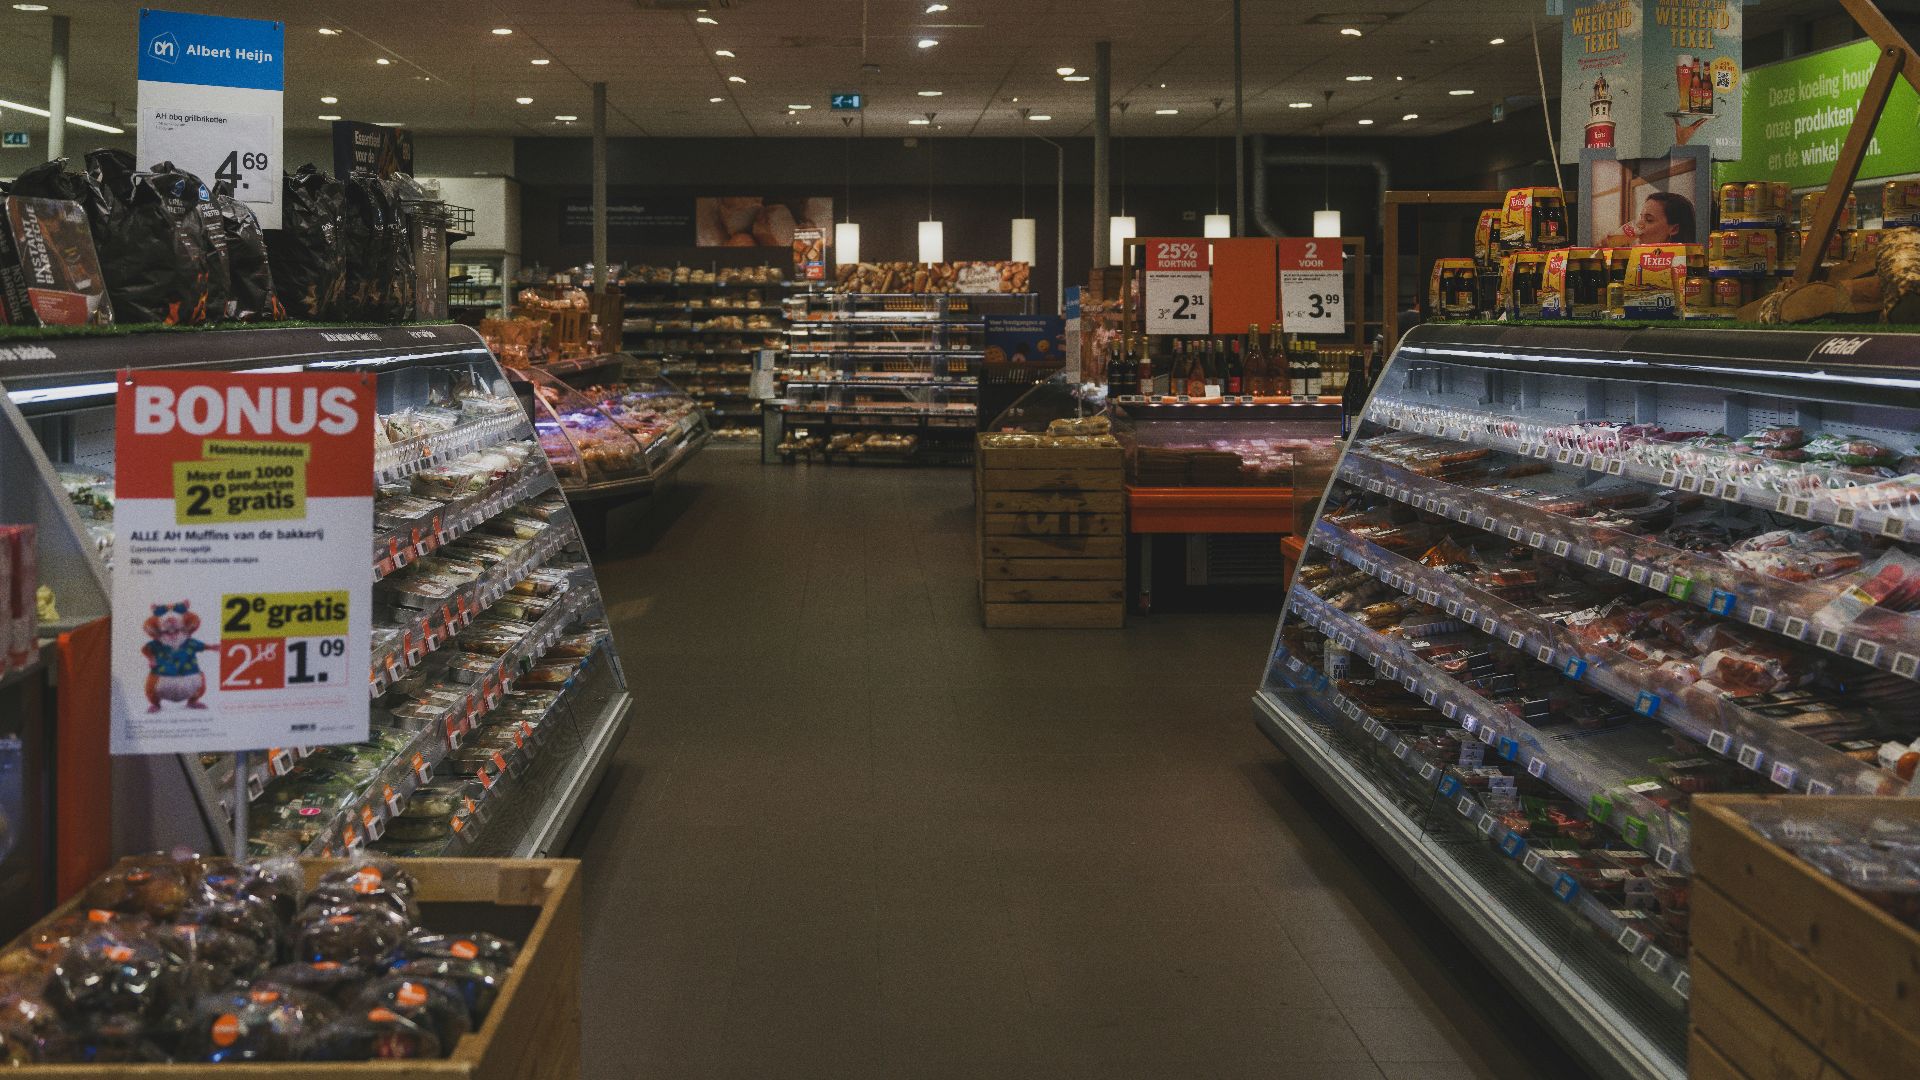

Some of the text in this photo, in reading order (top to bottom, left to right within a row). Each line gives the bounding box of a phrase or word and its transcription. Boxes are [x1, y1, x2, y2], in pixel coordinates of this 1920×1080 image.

[1572, 9, 1633, 36] WEEKEND
[1656, 7, 1730, 30] WEEKEND
[1584, 32, 1620, 54] TEXEL
[1671, 29, 1715, 49] TEXEL
[186, 43, 273, 64] Albert Heijn
[1768, 62, 1877, 108] Deze koeling houd
[155, 112, 168, 121] AH
[1766, 119, 1791, 140] onze
[1794, 105, 1853, 140] produkten
[1768, 153, 1781, 171] en
[1785, 145, 1798, 169] de
[1801, 137, 1839, 167] winkel
[1157, 243, 1198, 259] 25%
[1305, 242, 1317, 259] 2
[1642, 254, 1672, 267] TEXELS
[1158, 259, 1197, 268] KORTING
[1298, 259, 1323, 267] VOOR
[1818, 336, 1872, 355] Halal
[134, 385, 359, 436] BONUS
[186, 465, 294, 482] Meer dan 1000
[228, 481, 294, 493] producten
[186, 484, 295, 517] 2e gratis
[131, 529, 324, 541] ALLE AH Muffins van de bakkerij
[224, 597, 347, 632] 2e gratis
[288, 639, 345, 684] 1.09
